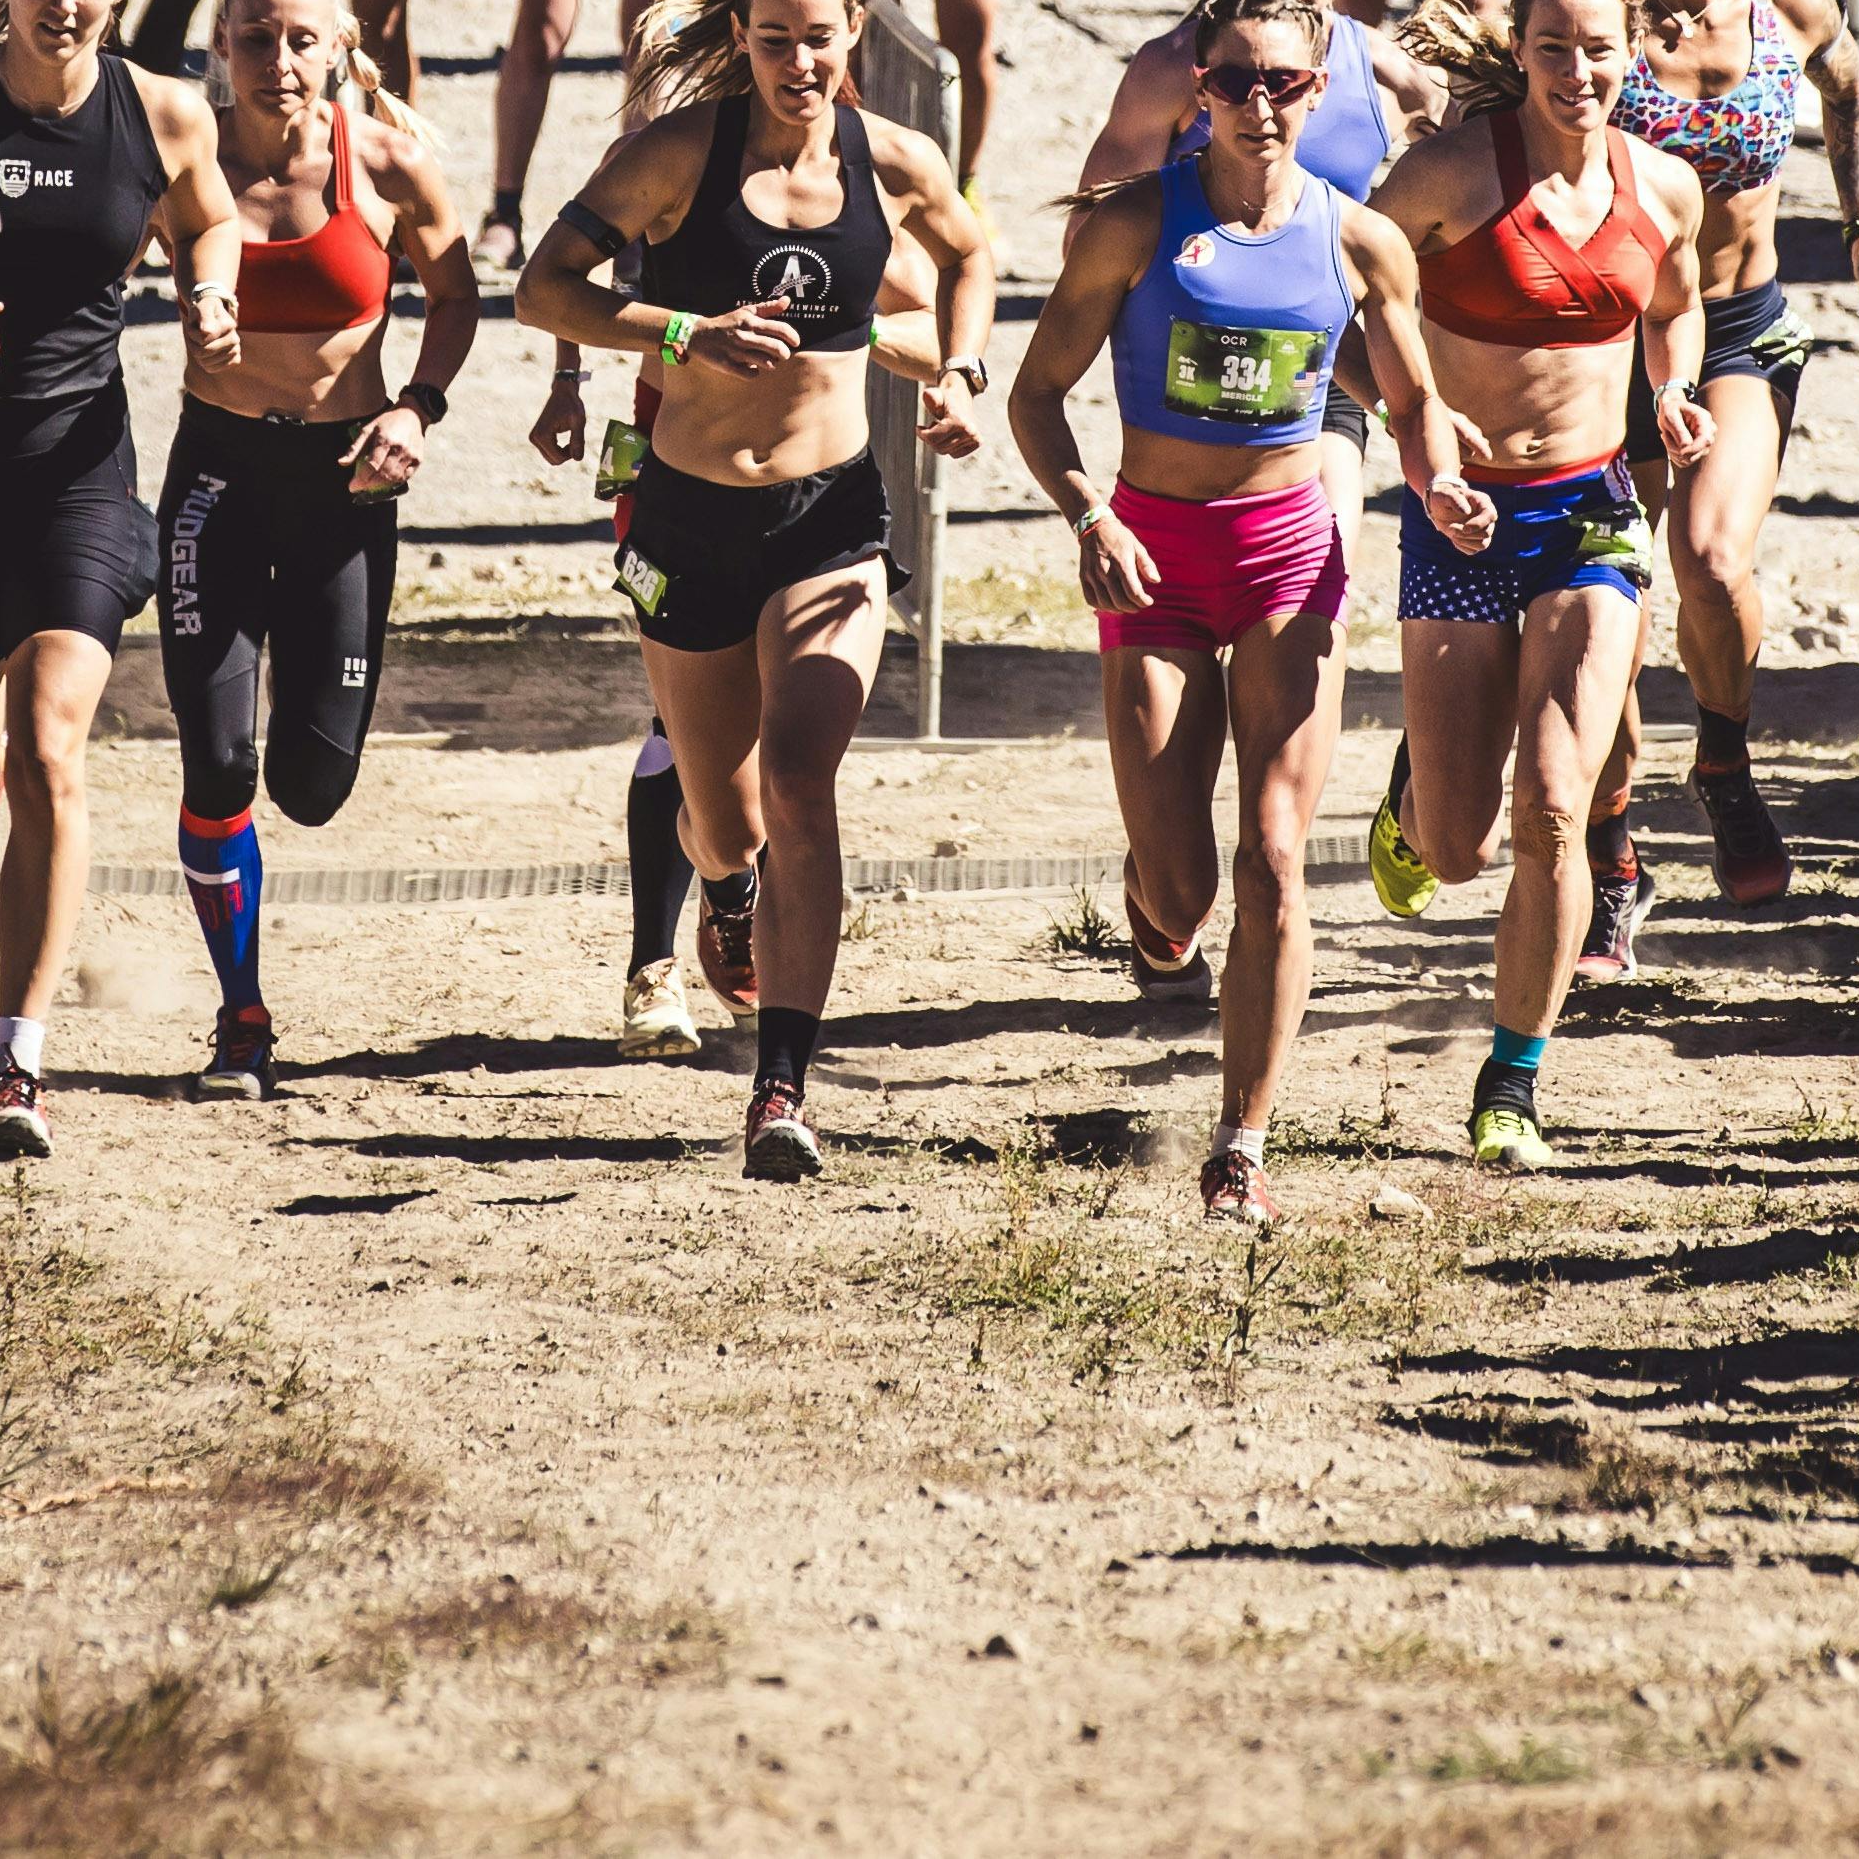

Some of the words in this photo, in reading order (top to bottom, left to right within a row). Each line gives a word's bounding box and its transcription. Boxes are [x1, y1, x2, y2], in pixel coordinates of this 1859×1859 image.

[34, 169, 74, 188] RACE
[790, 303, 826, 312] REWING
[1220, 335, 1248, 347] OCR
[1178, 364, 1196, 382] 3K
[1220, 355, 1272, 393] 334
[1221, 391, 1264, 403] MERICLE
[171, 472, 228, 636] MUDGEAR
[622, 548, 659, 603] 626
